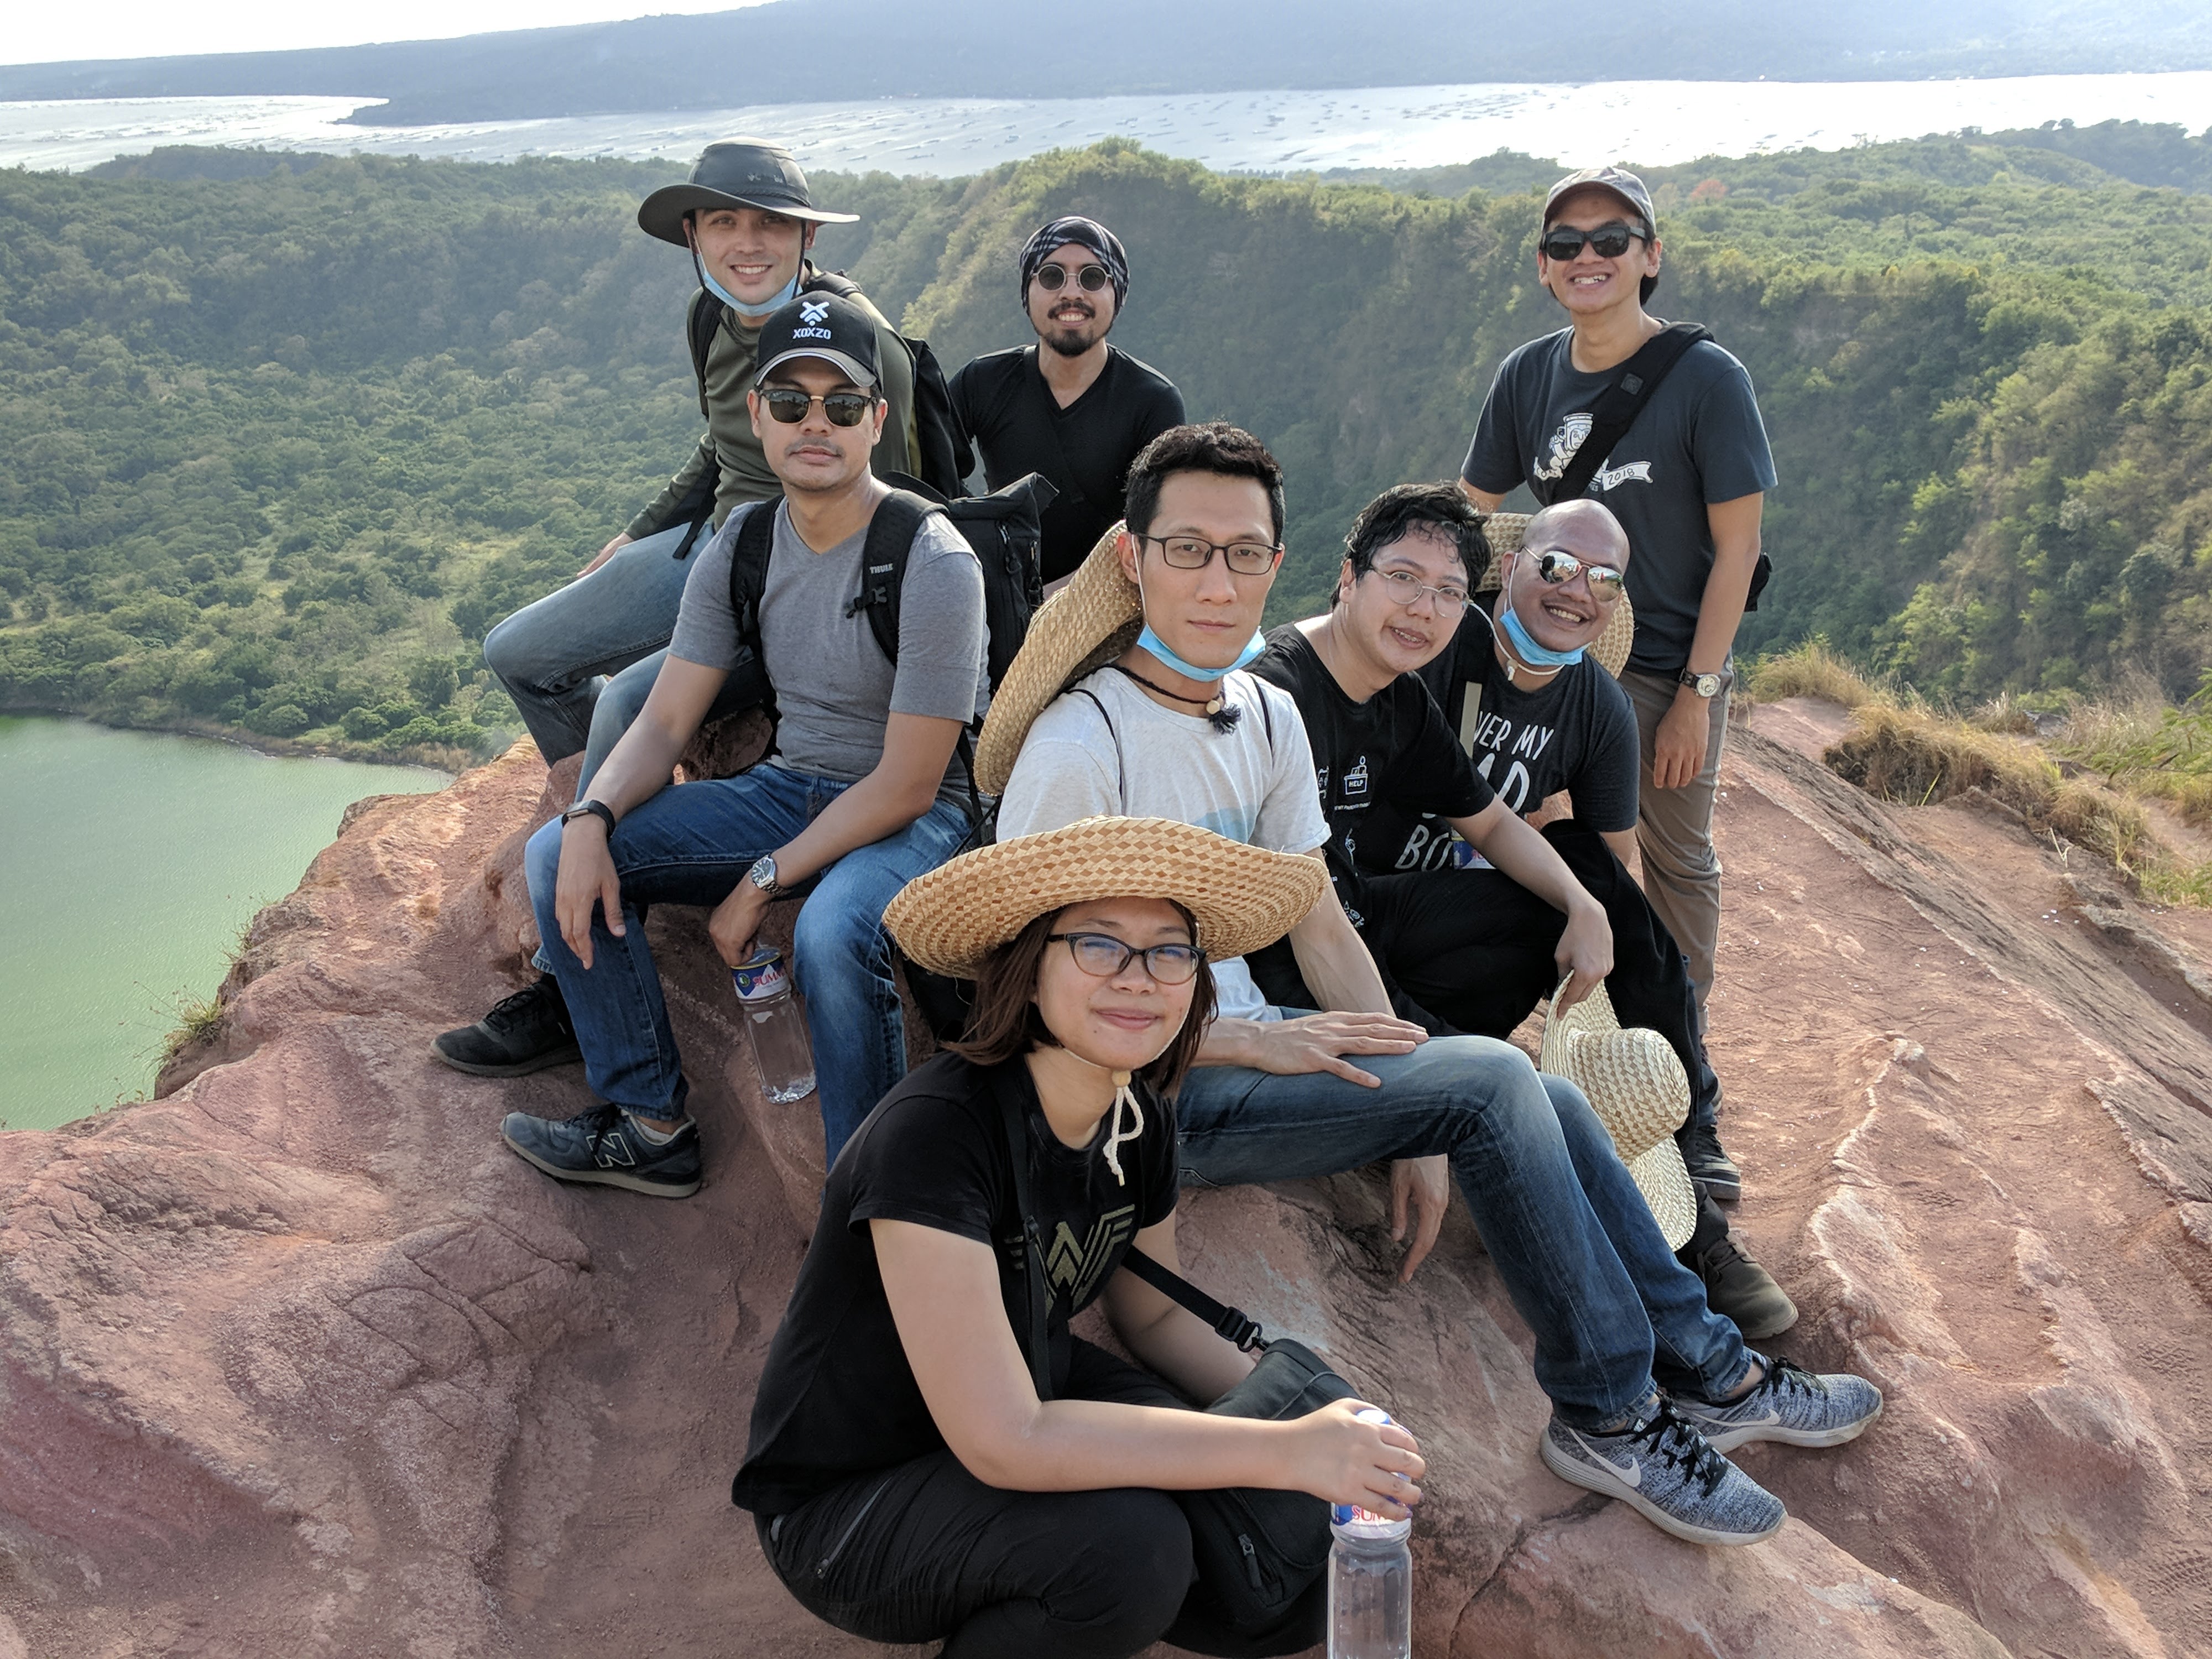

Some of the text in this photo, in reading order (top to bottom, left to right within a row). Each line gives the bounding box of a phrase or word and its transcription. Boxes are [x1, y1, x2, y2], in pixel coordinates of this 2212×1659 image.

[792, 327, 832, 340] XOXZO
[1608, 468, 1635, 486] 2018
[869, 563, 894, 574] THULE
[1473, 711, 1554, 760] VER MY
[1395, 824, 1453, 872] BO
